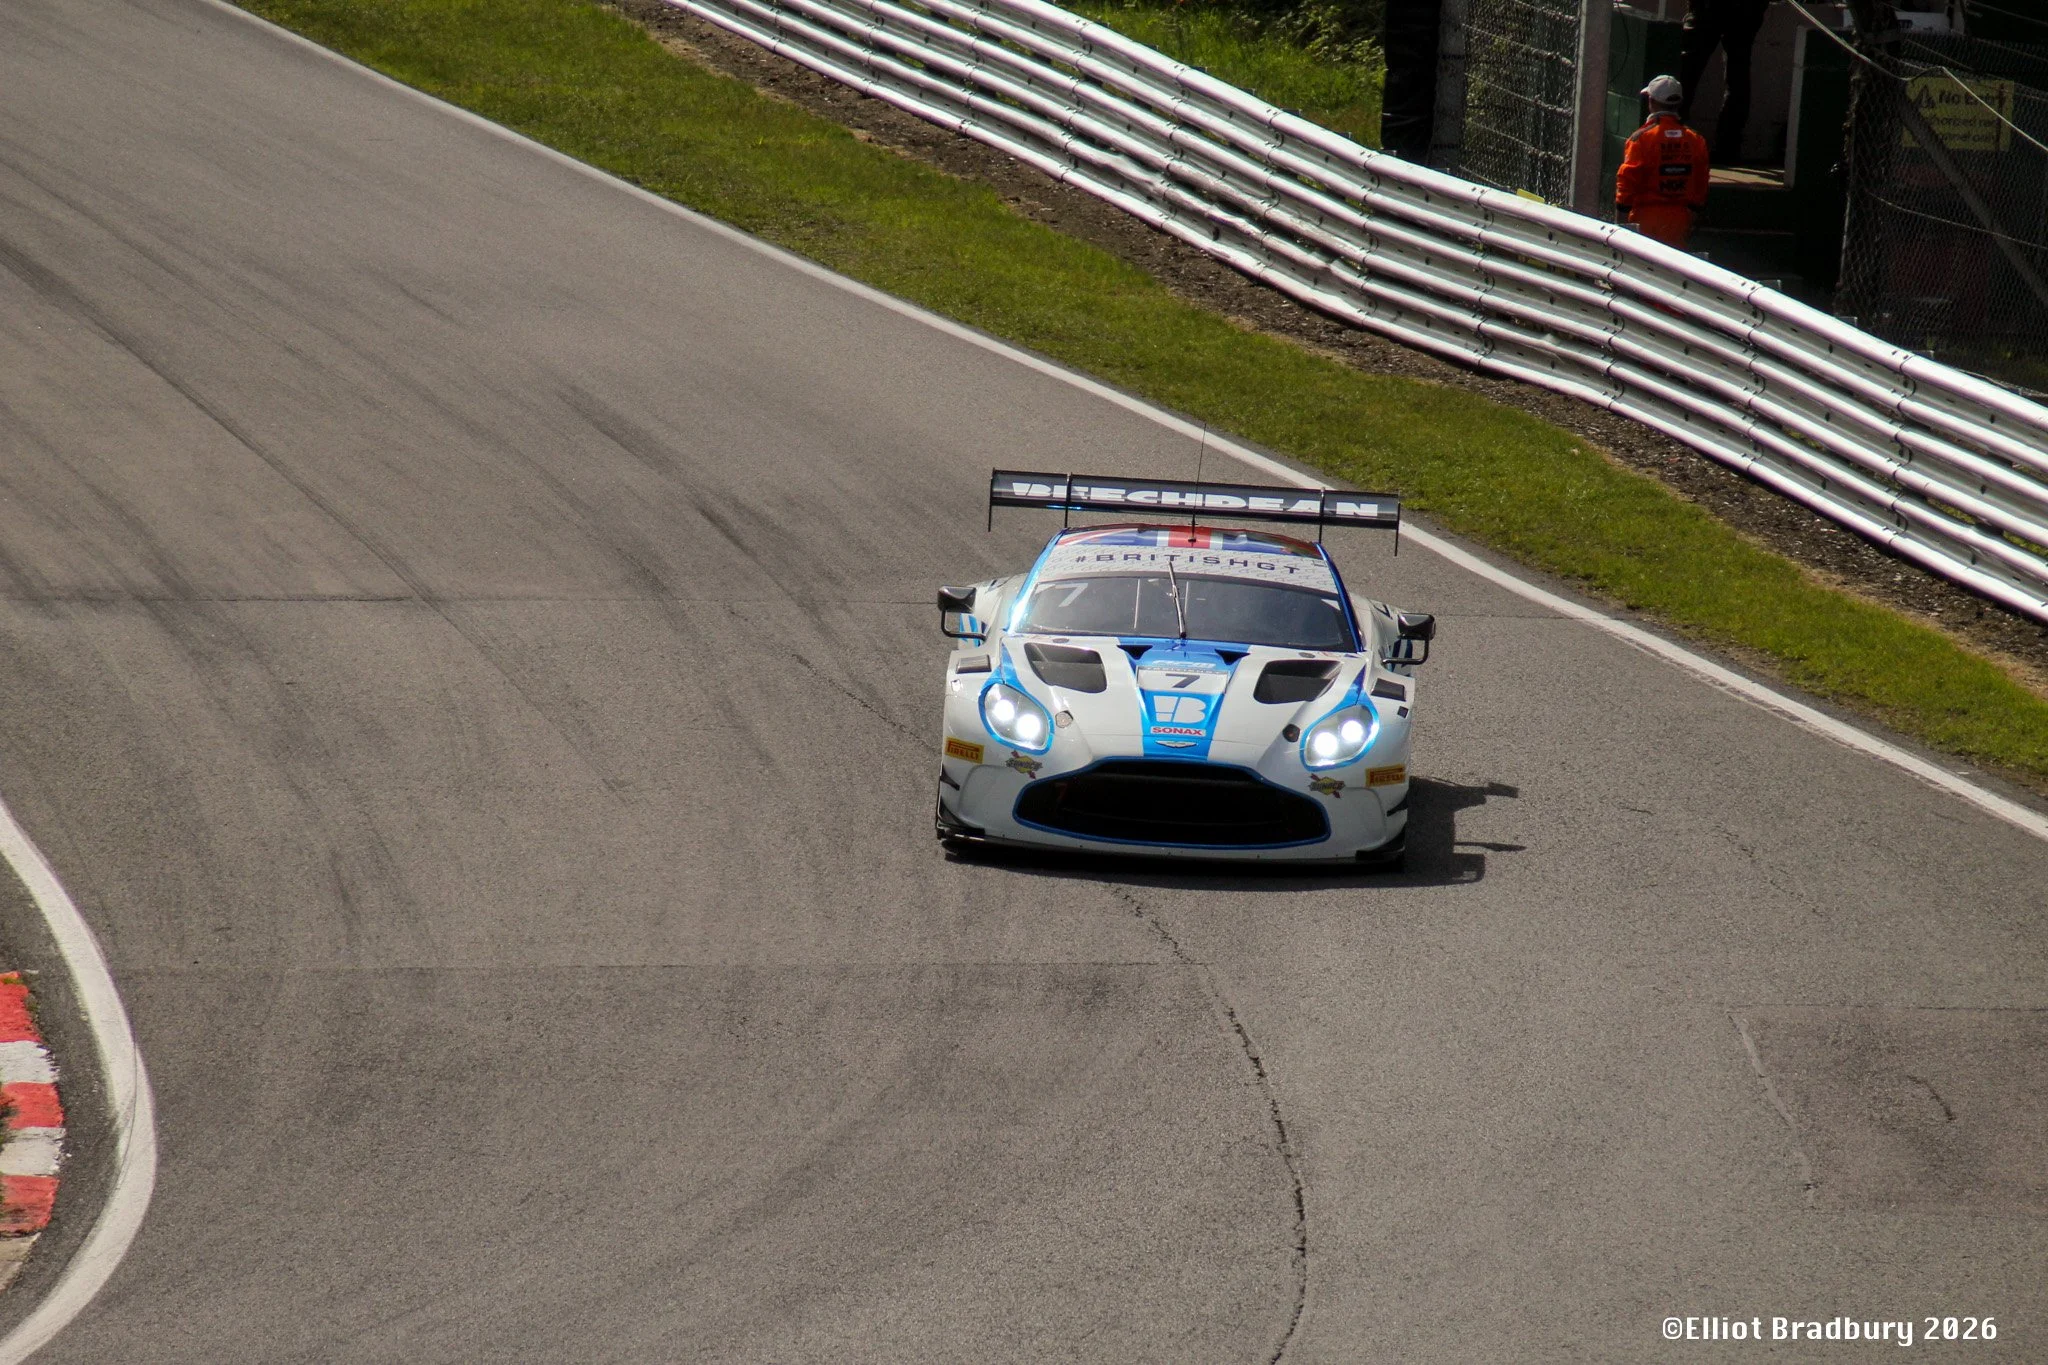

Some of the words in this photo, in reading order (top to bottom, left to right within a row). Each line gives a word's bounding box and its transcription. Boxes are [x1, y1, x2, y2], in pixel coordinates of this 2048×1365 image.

[1012, 482, 1378, 518] BEECHDEAN
[1076, 553, 1300, 574] #BRITISHGT
[1054, 582, 1089, 607] 7
[1165, 672, 1201, 689] 7
[1152, 726, 1203, 736] SONAX
[948, 740, 979, 761] PIRELLI
